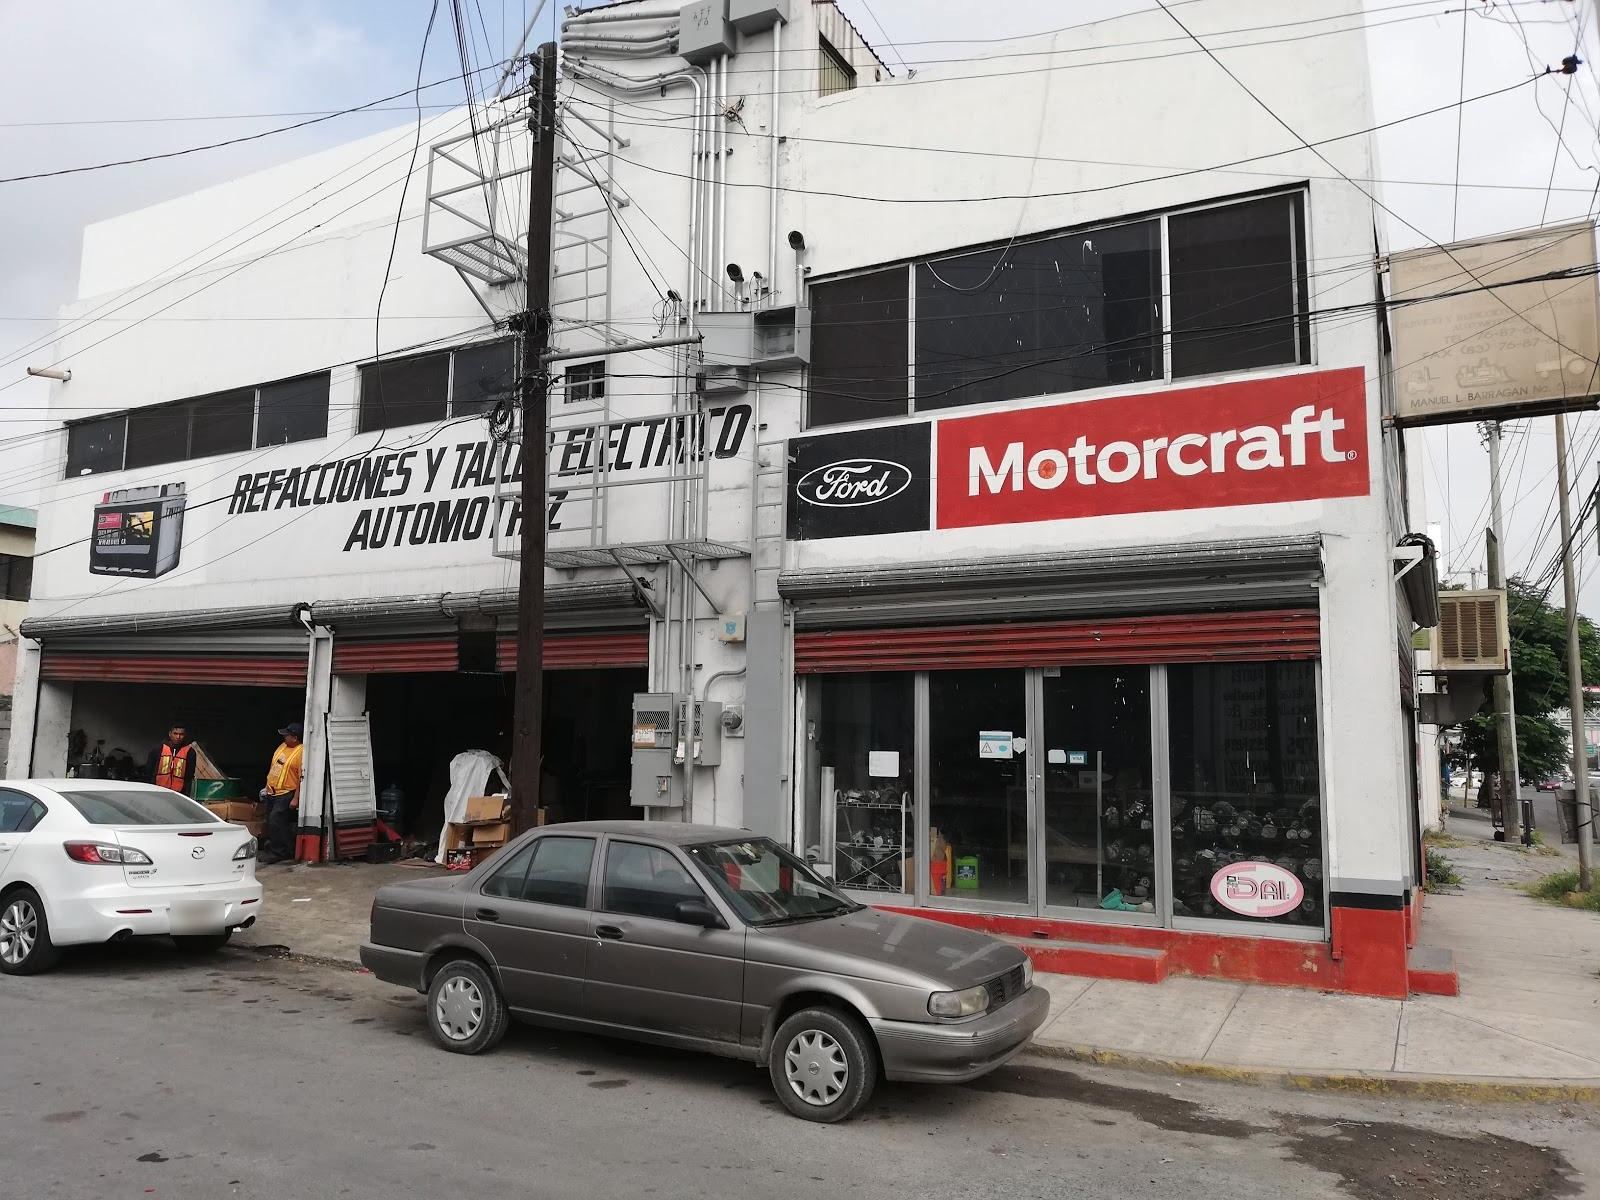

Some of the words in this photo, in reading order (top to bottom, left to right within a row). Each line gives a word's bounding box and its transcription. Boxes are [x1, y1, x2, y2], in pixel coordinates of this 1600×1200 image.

[1410, 395, 1452, 409] MANUEL
[1467, 386, 1528, 401] BARRAGAN
[967, 404, 1347, 497] Motorcraft
[228, 450, 418, 515] REFACCIONES
[423, 446, 448, 494] Y
[815, 465, 889, 501] Ford
